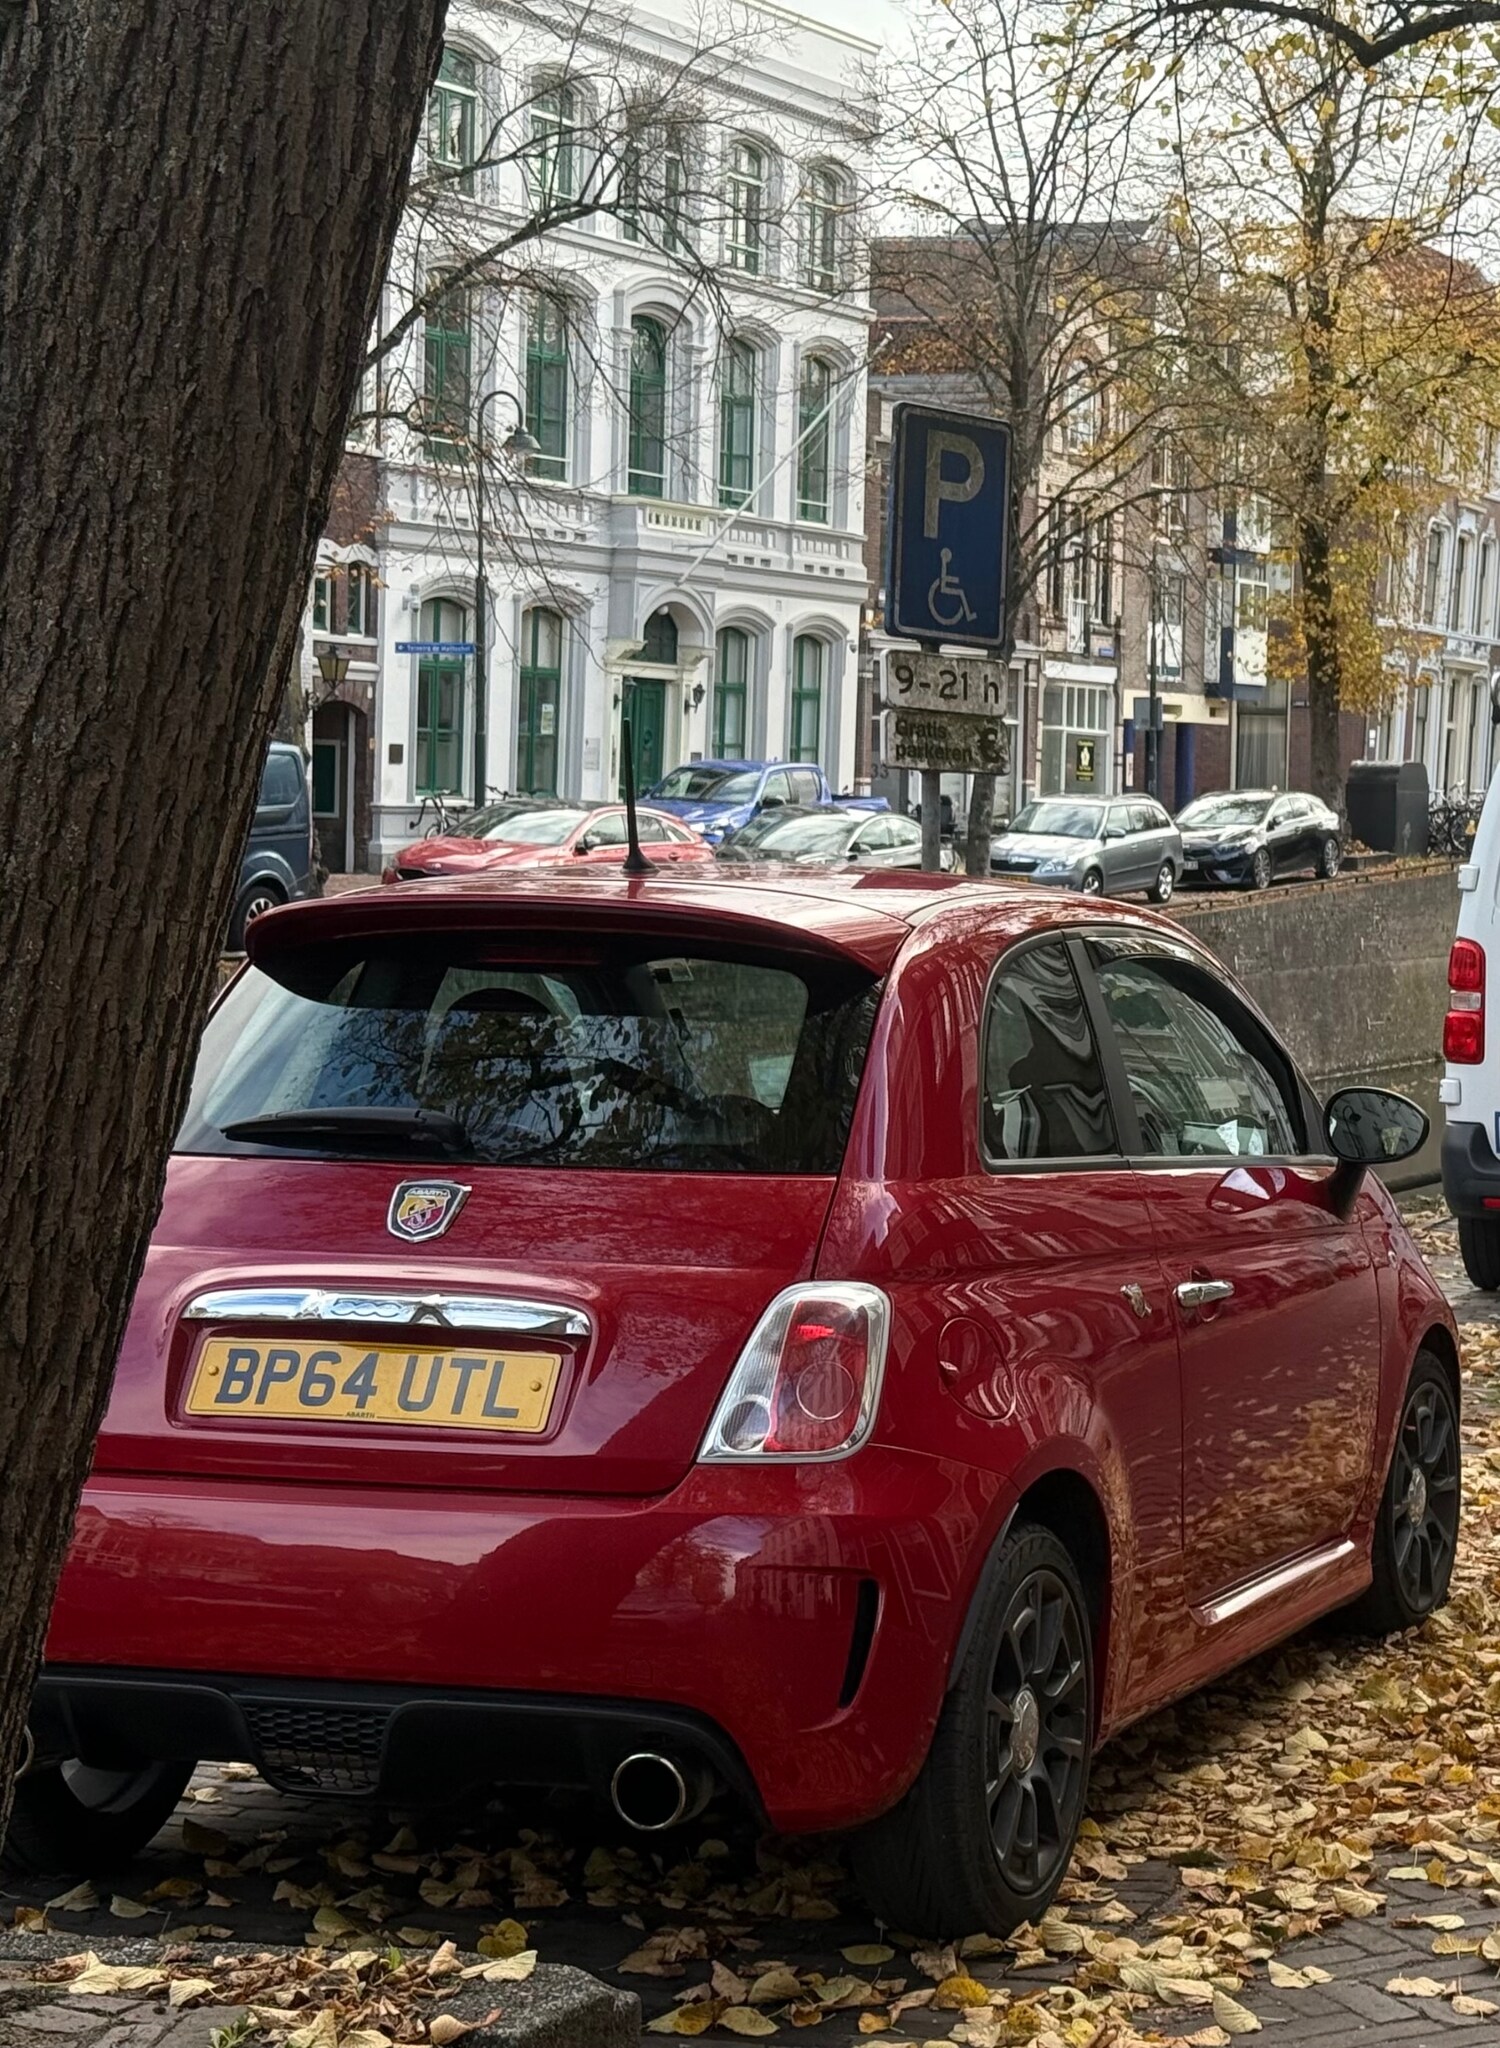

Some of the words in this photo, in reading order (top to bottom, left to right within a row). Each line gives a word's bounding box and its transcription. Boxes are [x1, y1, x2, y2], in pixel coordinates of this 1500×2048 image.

[923, 429, 986, 540] P
[894, 664, 968, 702] 9-21
[983, 673, 999, 704] h
[895, 719, 948, 739] Gratis
[895, 742, 973, 761] parkeren
[214, 1348, 380, 1409] BP64
[397, 1355, 520, 1419] UTL
[345, 1411, 376, 1419] ABARTH
